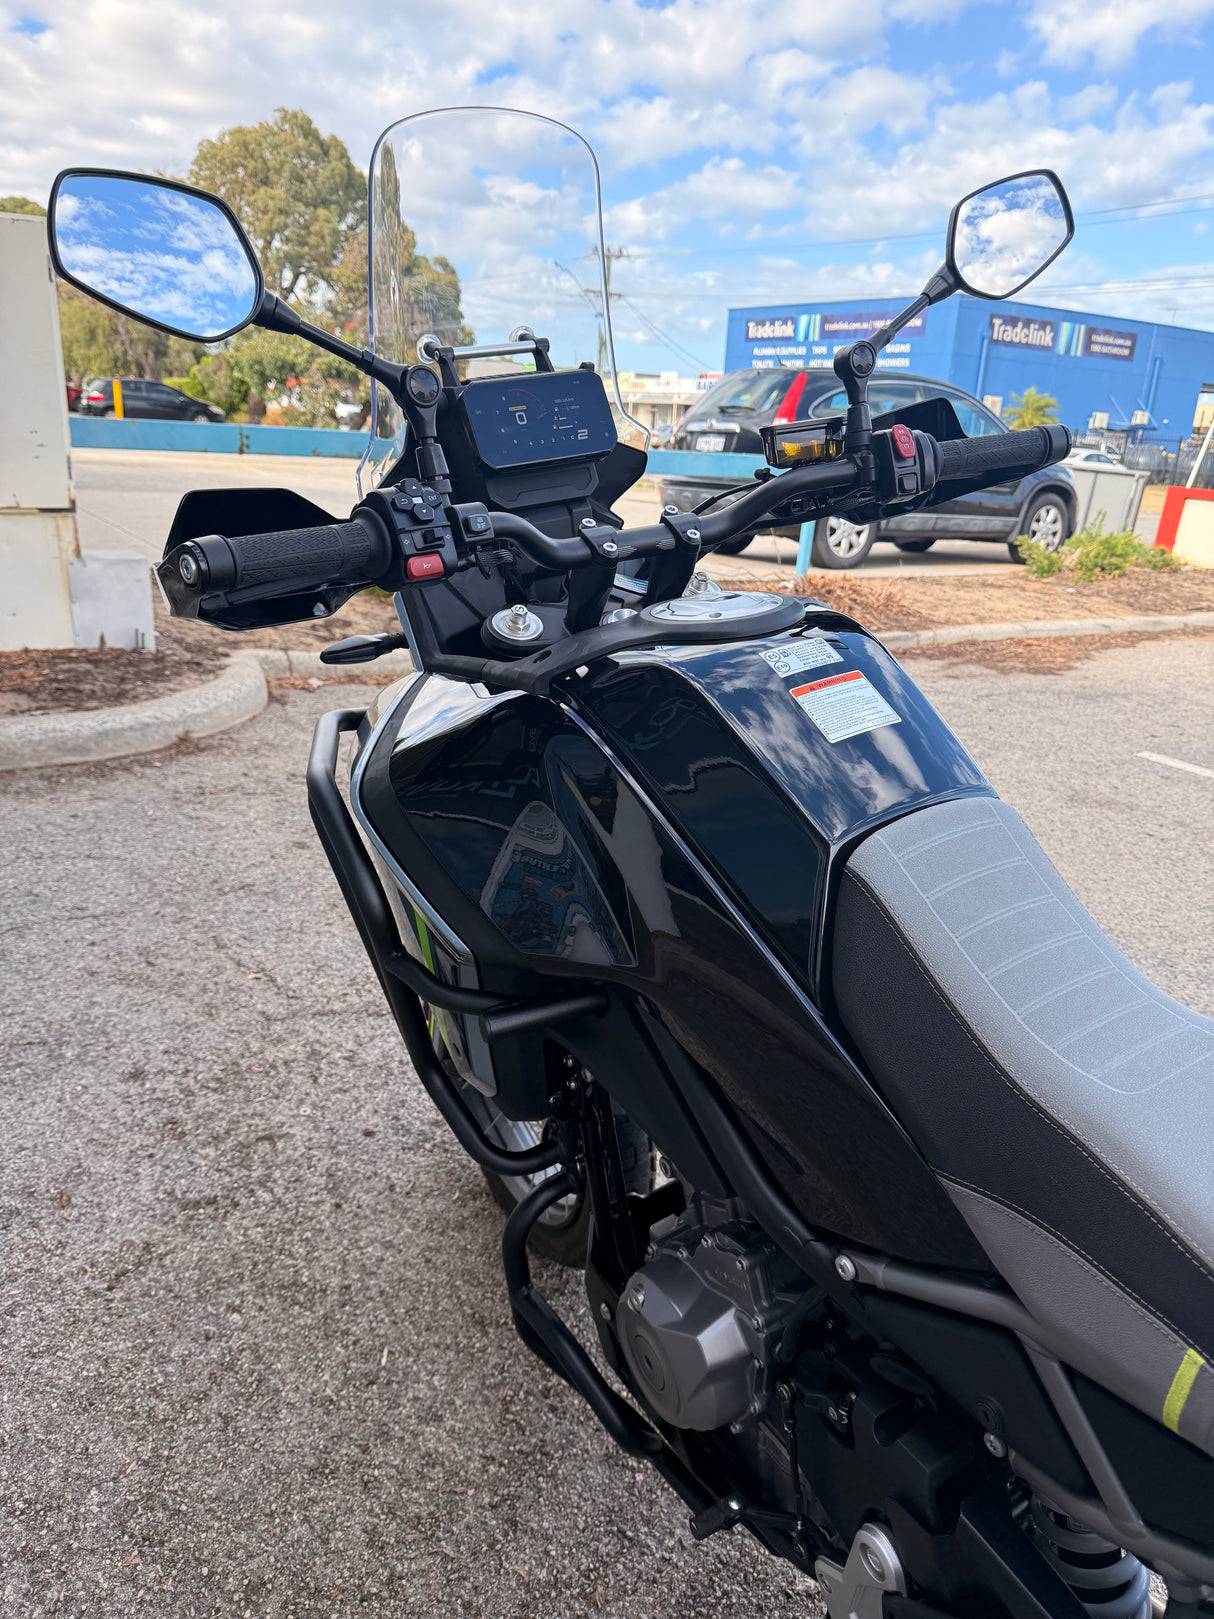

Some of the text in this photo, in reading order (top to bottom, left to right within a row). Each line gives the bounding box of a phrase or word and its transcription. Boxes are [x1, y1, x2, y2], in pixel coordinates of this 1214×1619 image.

[747, 320, 795, 339] Tradelink
[992, 318, 1054, 347] Tradelink
[877, 357, 910, 367] SHOWERS
[817, 676, 847, 688] WARNING
